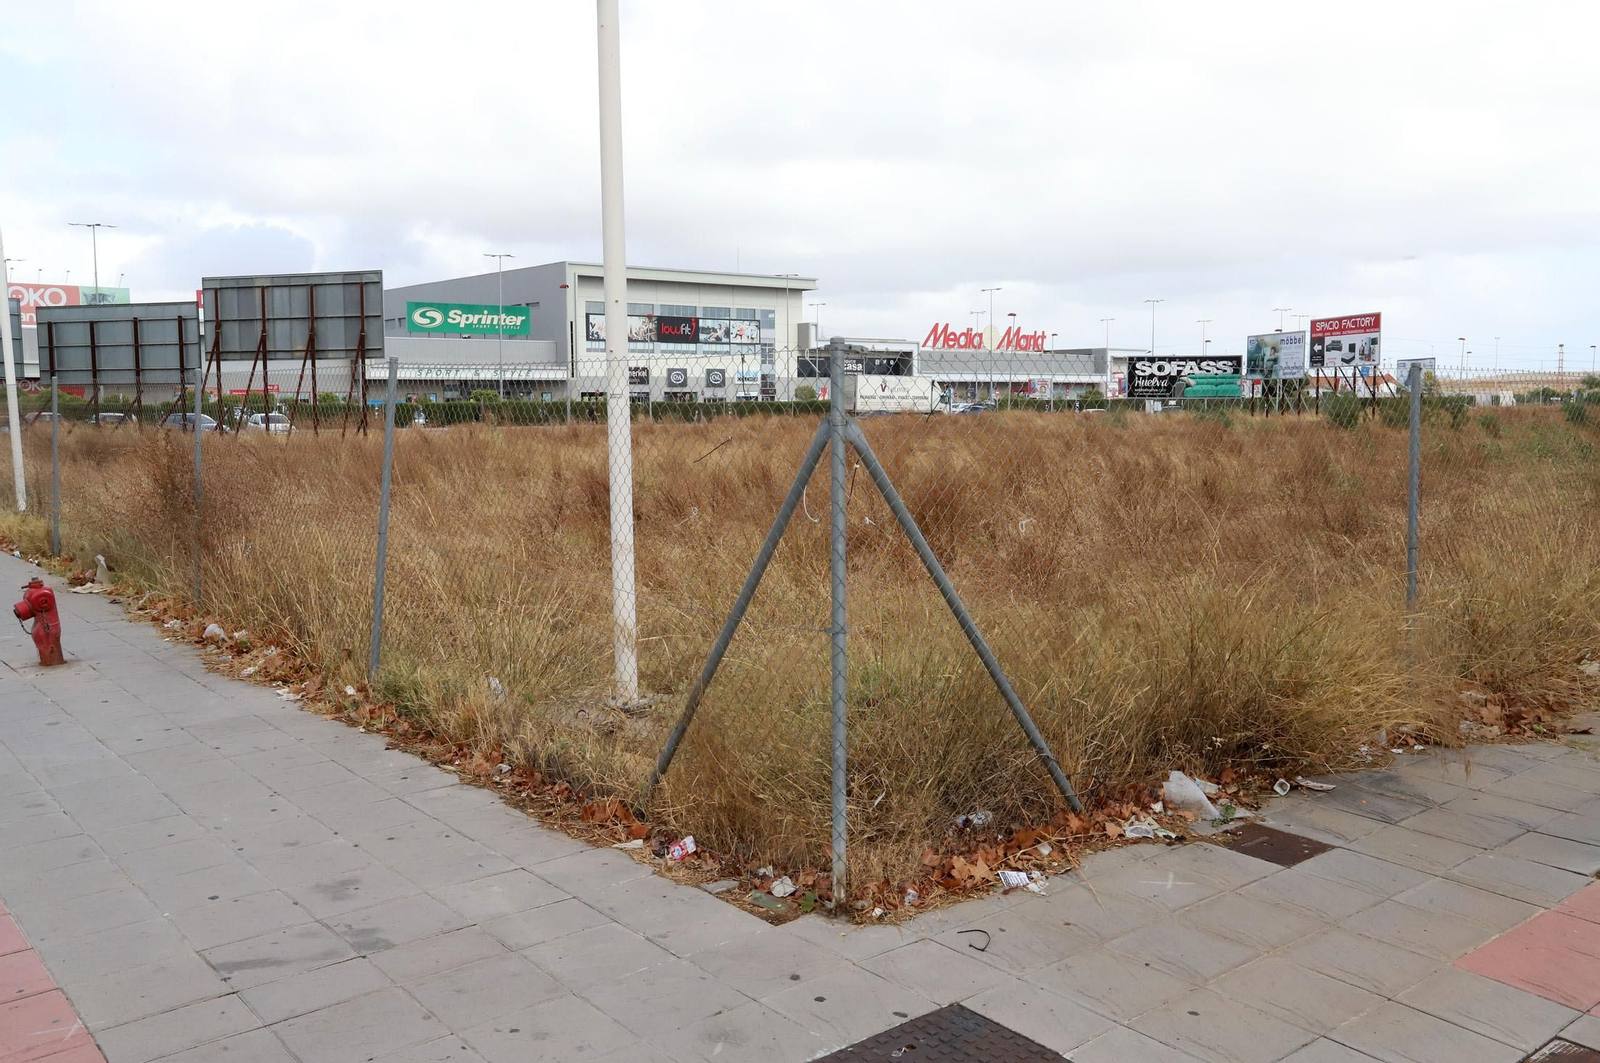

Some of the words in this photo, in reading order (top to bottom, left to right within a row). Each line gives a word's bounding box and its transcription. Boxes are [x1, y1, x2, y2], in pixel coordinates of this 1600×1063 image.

[447, 310, 525, 328] Sprinter
[1316, 321, 1339, 332] SPACIO
[1342, 317, 1375, 329] FACTORY
[921, 323, 983, 350] Media
[996, 326, 1046, 352] Markt
[1280, 335, 1303, 346] möbbel
[417, 369, 460, 377] SPORT
[493, 369, 532, 378] STYLE
[1135, 361, 1233, 376] SOFASS
[1135, 377, 1169, 388] Huelva
